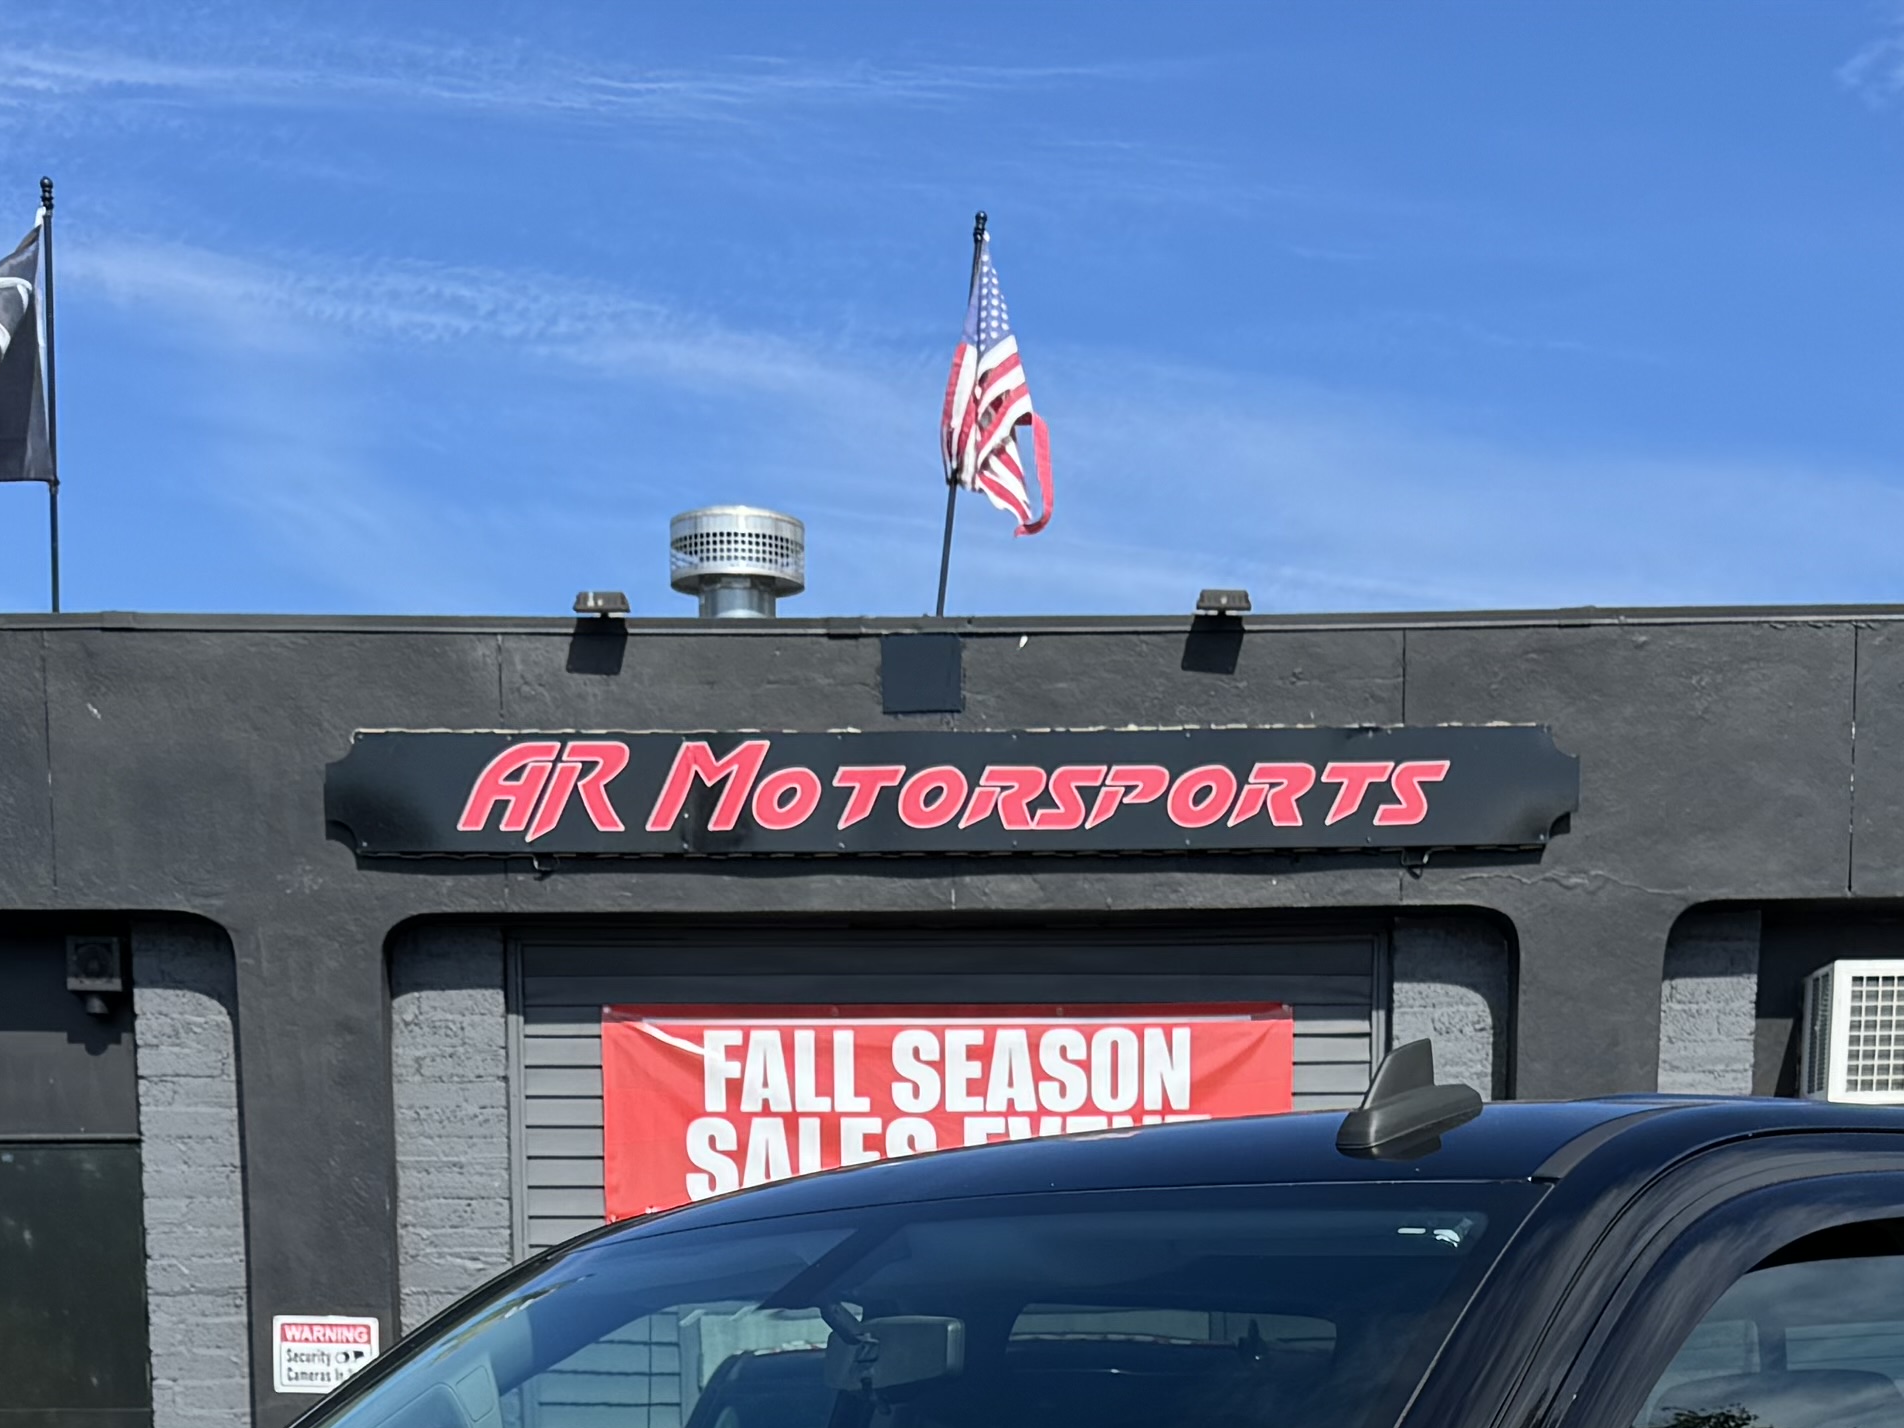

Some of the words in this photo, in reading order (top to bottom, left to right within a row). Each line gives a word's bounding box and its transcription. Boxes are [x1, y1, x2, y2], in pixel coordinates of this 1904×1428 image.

[457, 741, 629, 842] AR
[702, 1029, 871, 1113] FALL
[891, 1027, 1191, 1113] SEASON
[283, 1324, 368, 1343] WARNING
[286, 1348, 331, 1367] Security
[286, 1367, 332, 1382] Cameras
